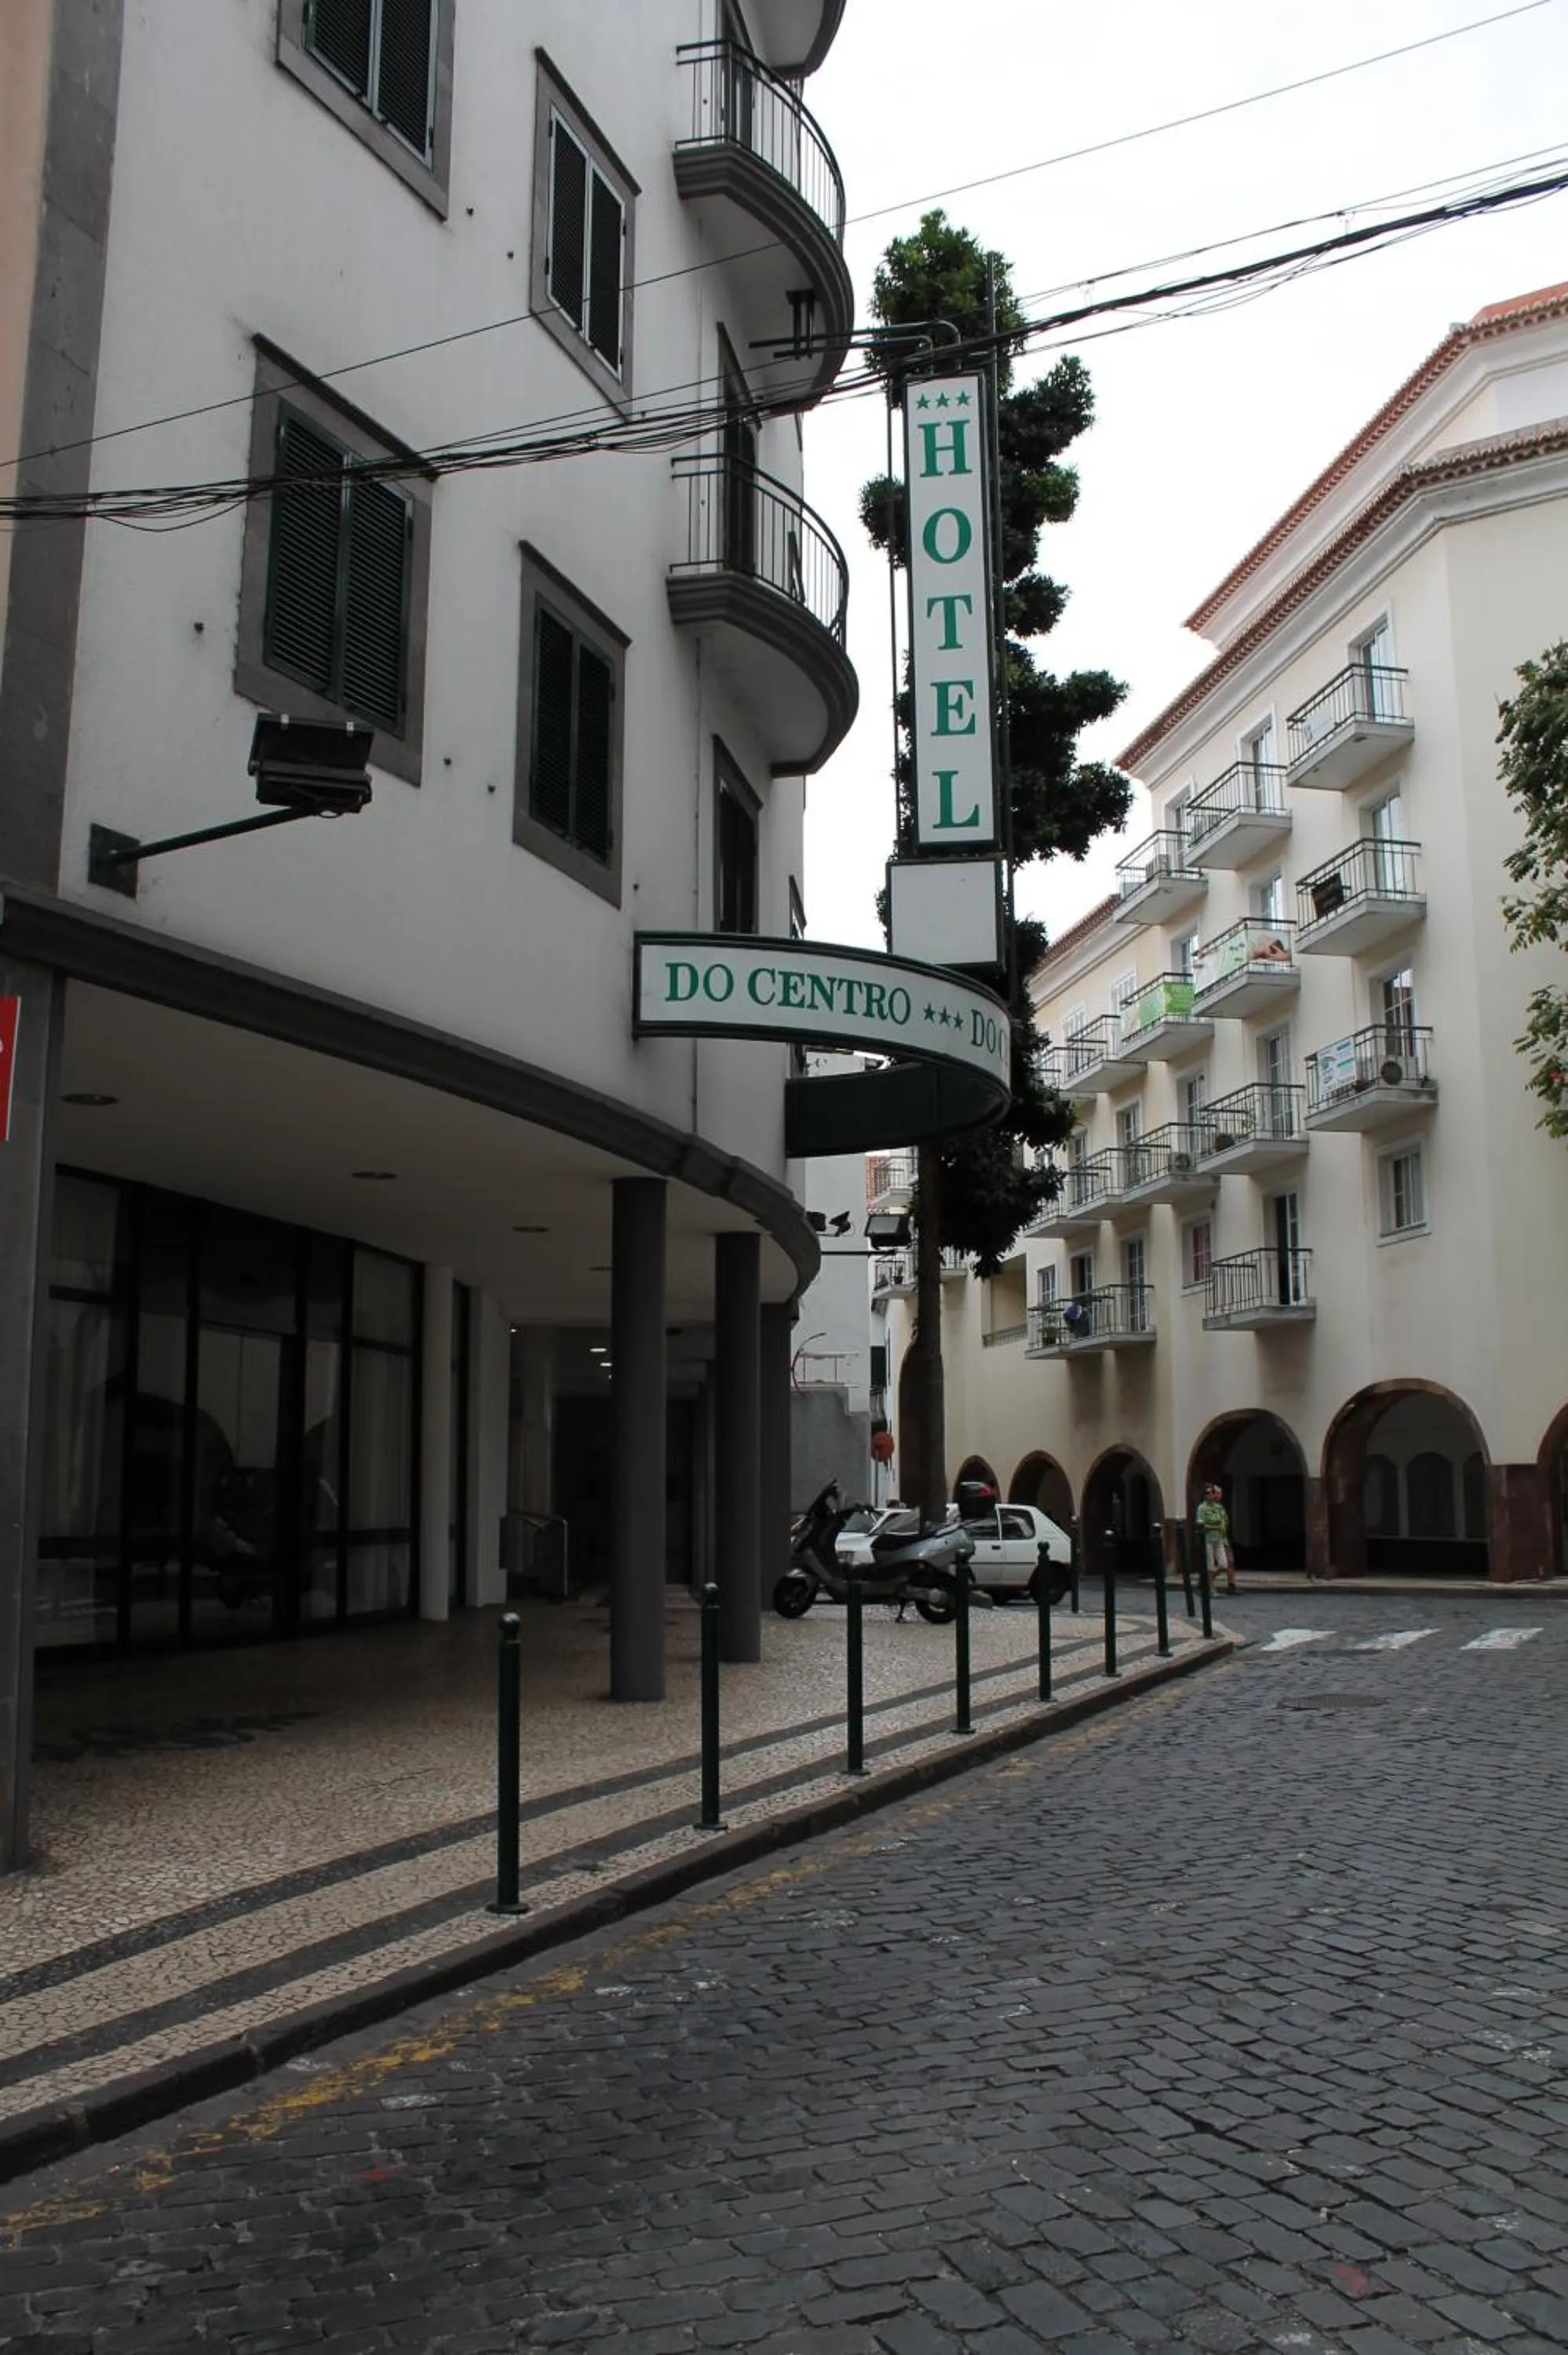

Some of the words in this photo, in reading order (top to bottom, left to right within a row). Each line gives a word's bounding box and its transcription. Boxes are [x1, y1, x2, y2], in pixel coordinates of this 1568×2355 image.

[917, 418, 980, 830] HOTEL
[665, 962, 735, 1002] DO
[746, 966, 912, 1025] CENTRO
